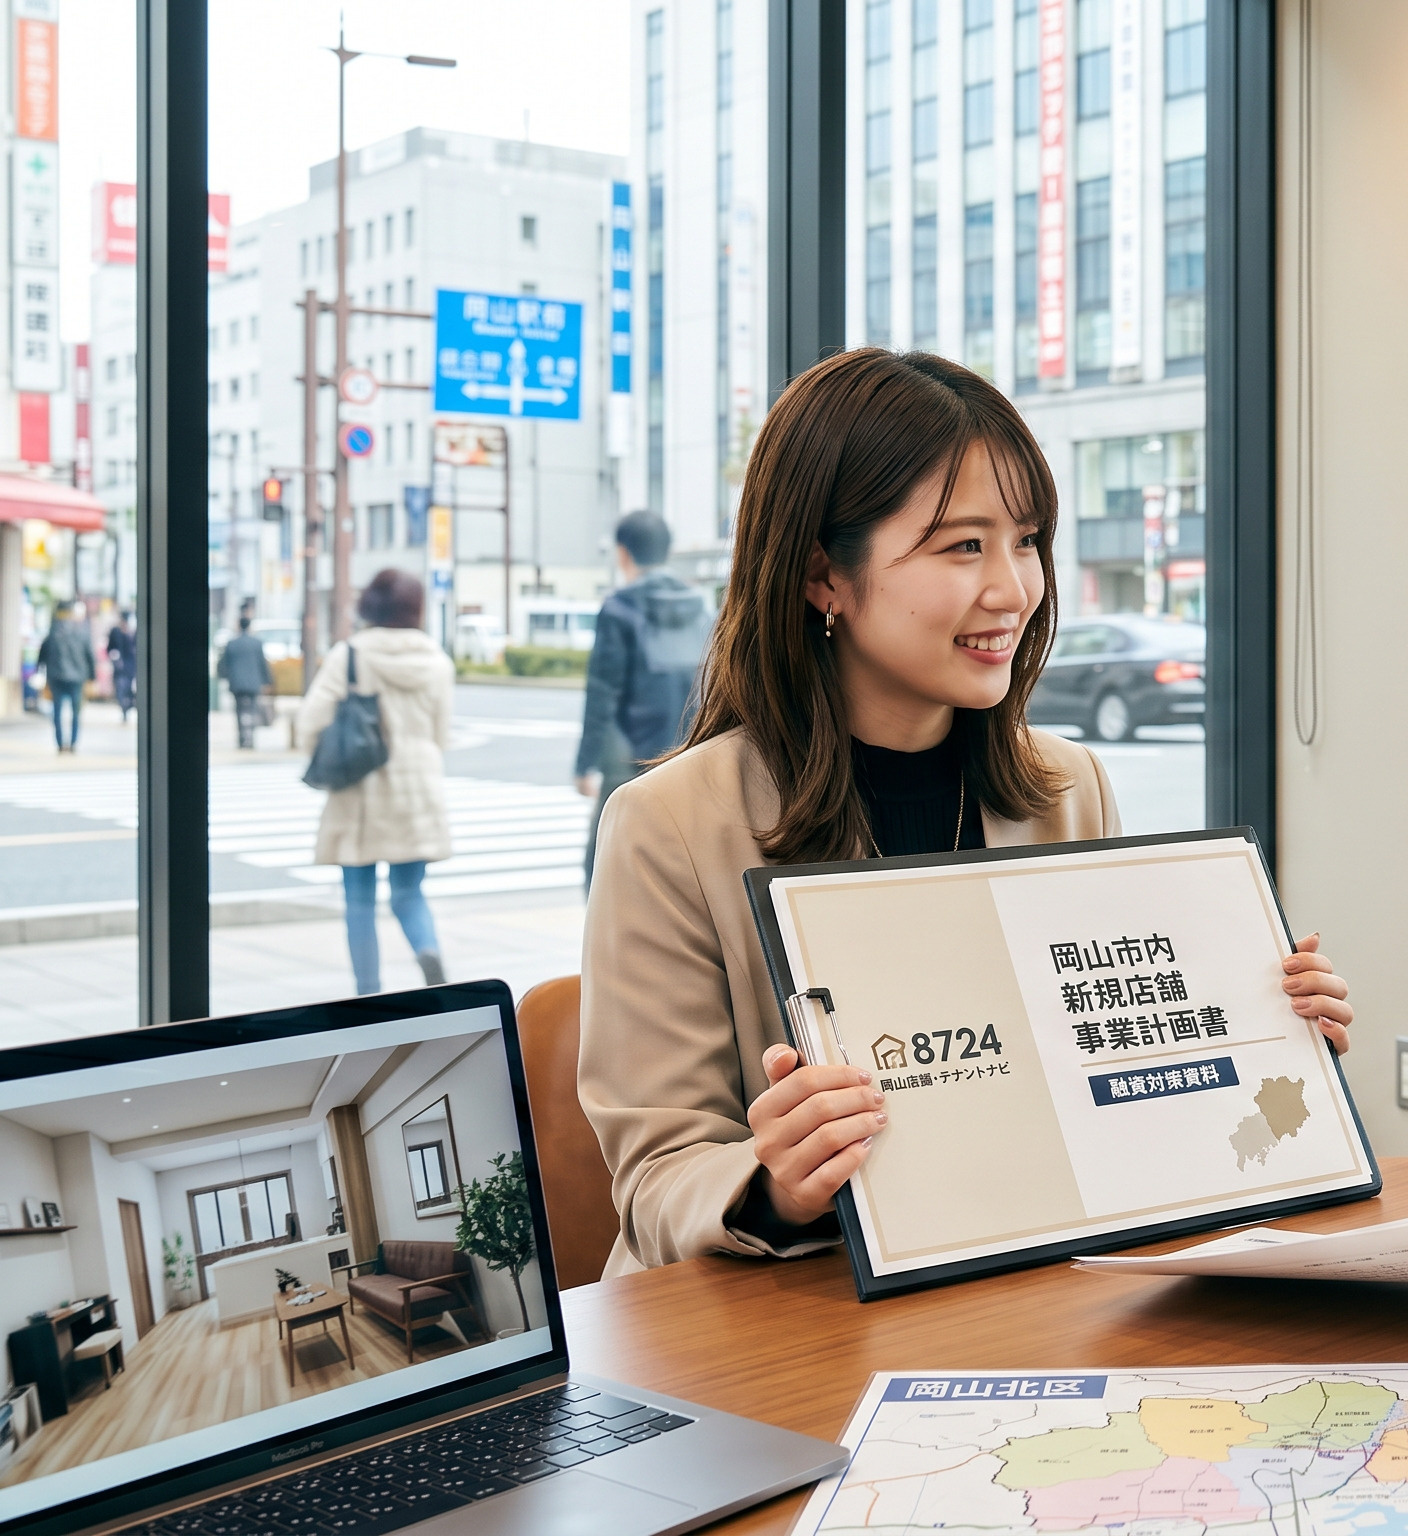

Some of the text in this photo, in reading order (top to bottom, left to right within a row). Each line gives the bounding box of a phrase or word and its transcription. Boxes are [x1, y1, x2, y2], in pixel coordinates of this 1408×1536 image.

[1049, 932, 1177, 975] 岡山市内
[1060, 970, 1189, 1014] 新規店舗
[911, 1023, 1003, 1065] 8724
[1071, 1005, 1229, 1055] 事業計画書
[1108, 1063, 1220, 1099] 融資対策資料
[904, 1379, 1086, 1399] 岡山北区
